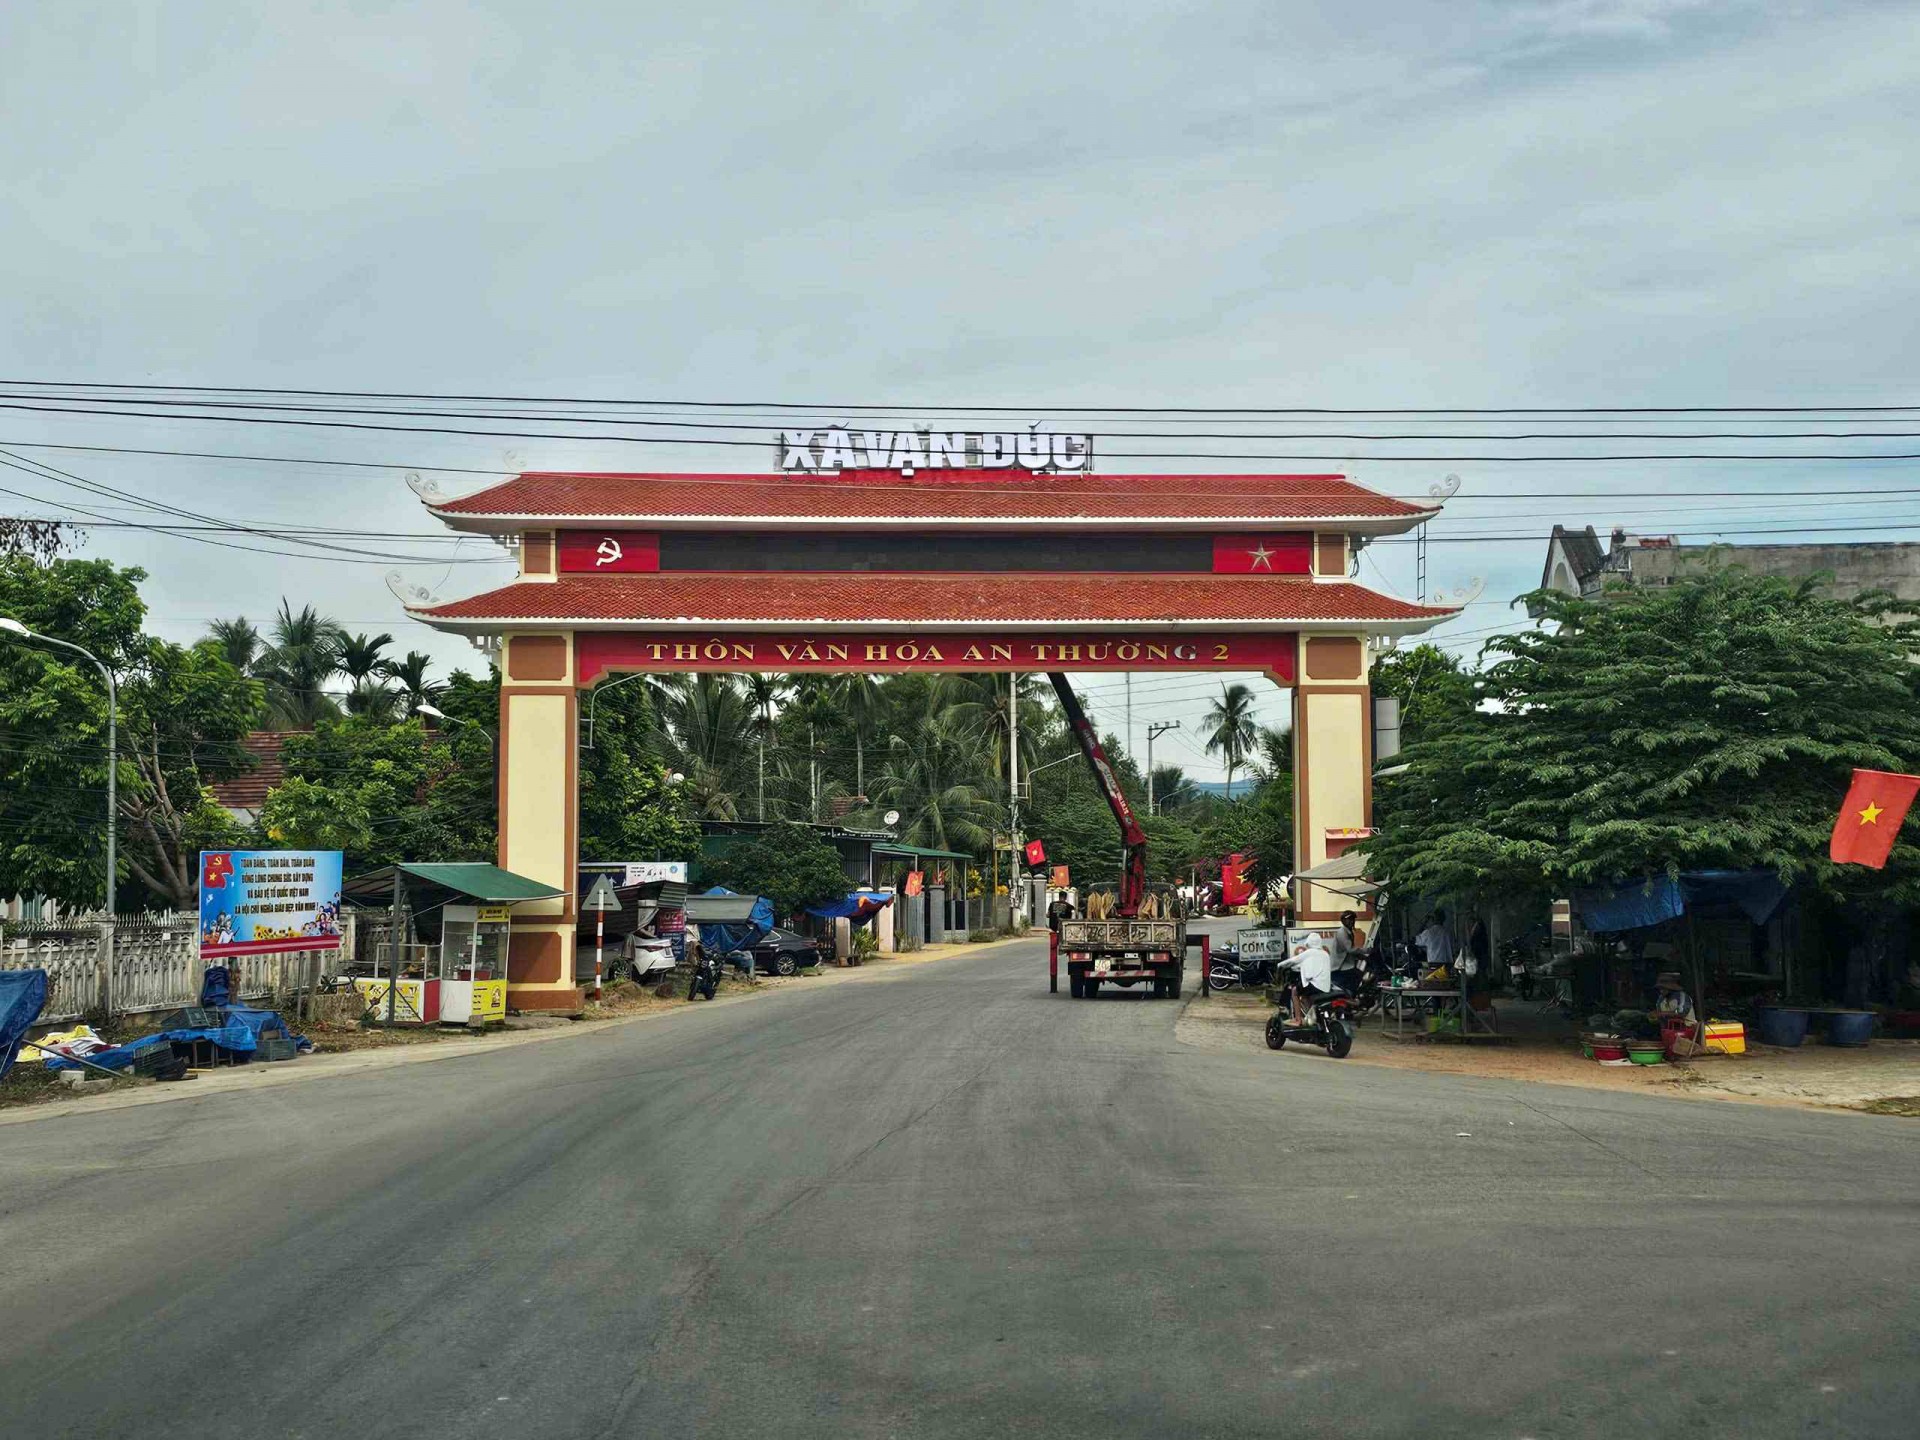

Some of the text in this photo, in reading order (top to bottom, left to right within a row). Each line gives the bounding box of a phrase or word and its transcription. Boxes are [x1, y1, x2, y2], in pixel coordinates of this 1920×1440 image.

[863, 431, 965, 476] VẠN
[982, 419, 1087, 469] ĐỨC
[646, 638, 1229, 661] THÔN VĂN HÓA AN THƯỜNG 2
